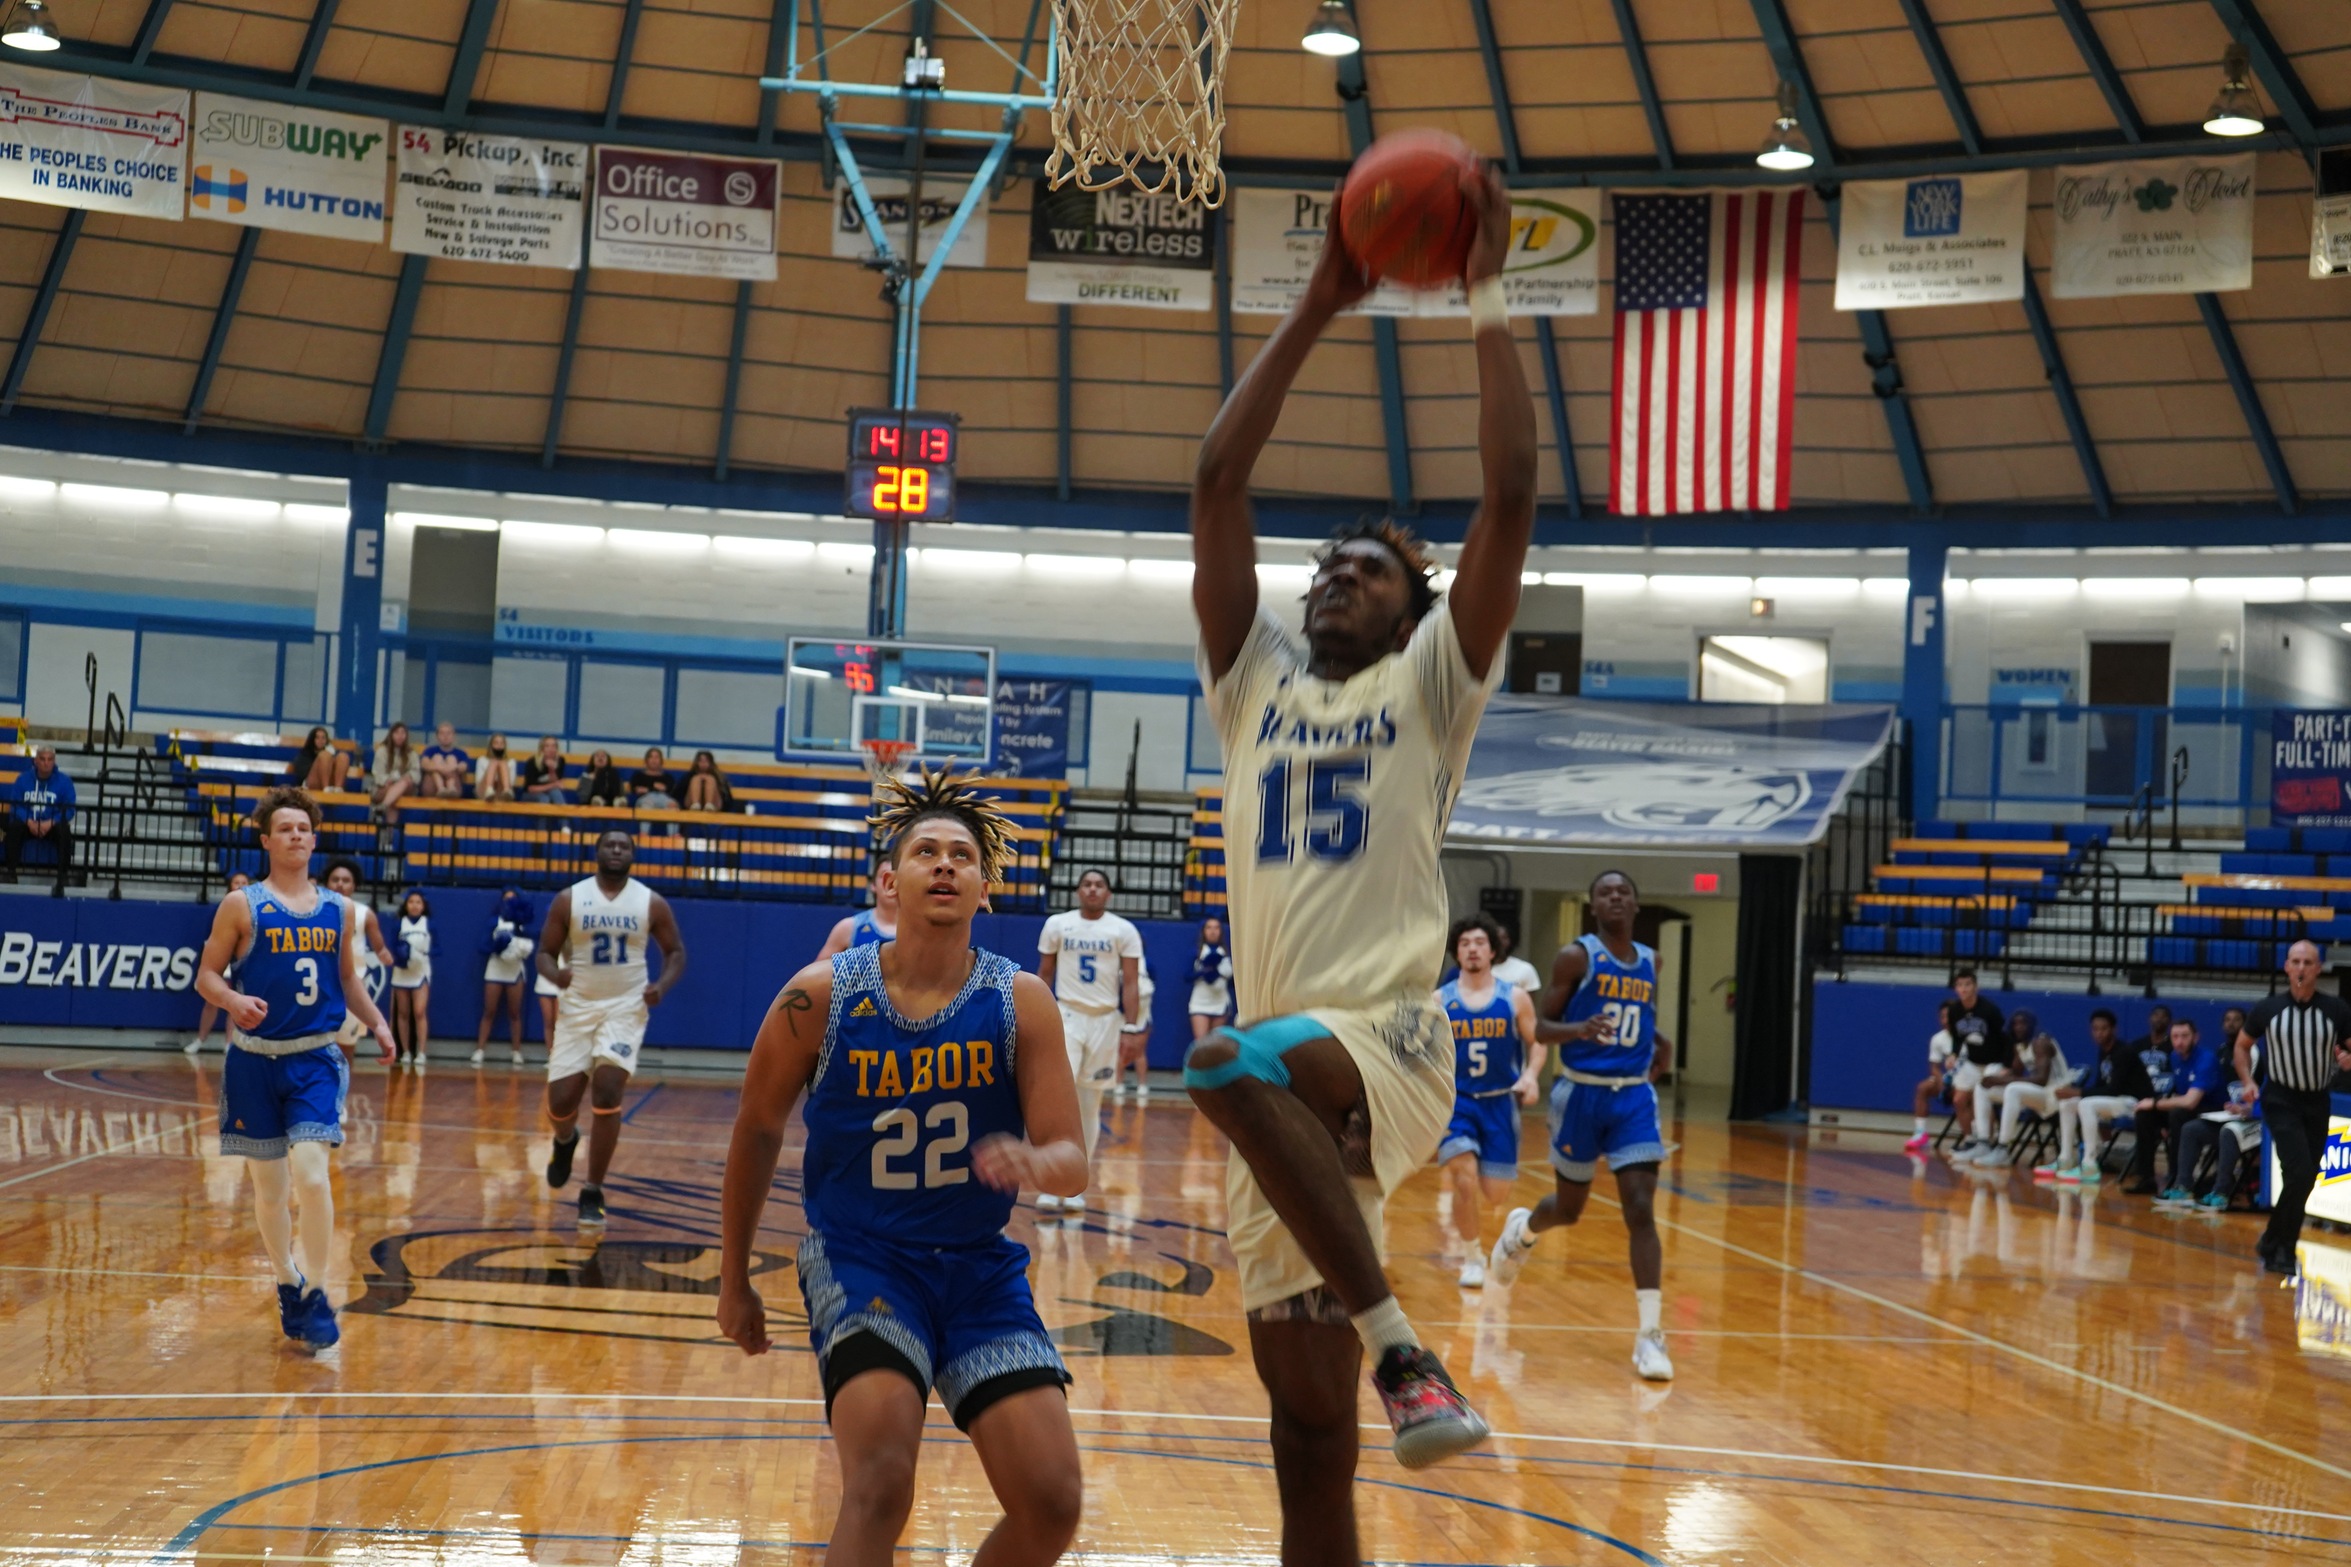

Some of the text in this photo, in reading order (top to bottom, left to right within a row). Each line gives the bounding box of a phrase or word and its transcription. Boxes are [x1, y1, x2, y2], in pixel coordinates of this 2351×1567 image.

[200, 110, 383, 162] SUBWAY
[403, 130, 431, 153] 54
[30, 146, 107, 173] PEOPLES
[114, 159, 178, 182] CHOICE
[33, 169, 133, 198] IN BANKING
[607, 164, 699, 199] Office
[264, 187, 383, 220] HUTTON
[603, 204, 748, 242] Solutions
[1051, 225, 1203, 258] wireless
[1941, 237, 2008, 250] Associates
[1078, 282, 1181, 302] DIFFERENT
[1514, 277, 1595, 290] Partnership
[1517, 292, 1563, 307] Family
[873, 465, 929, 513] 28
[353, 528, 378, 577] E
[503, 624, 595, 644] VISITORS
[1911, 596, 1936, 645] F
[1995, 668, 2072, 684] WOMEN
[1257, 756, 1371, 864] 15
[582, 914, 638, 931] BEAVERS
[264, 927, 337, 954] TABOR
[591, 931, 629, 965] 21
[1063, 937, 1113, 953] BEAVERS
[0, 931, 198, 991] BEAVERS
[1079, 954, 1097, 983] 5
[295, 957, 318, 1006] 3
[1451, 1018, 1508, 1039] TABOR
[848, 1040, 996, 1097] TABOR
[1467, 1041, 1488, 1078] 5
[871, 1100, 970, 1190] 22
